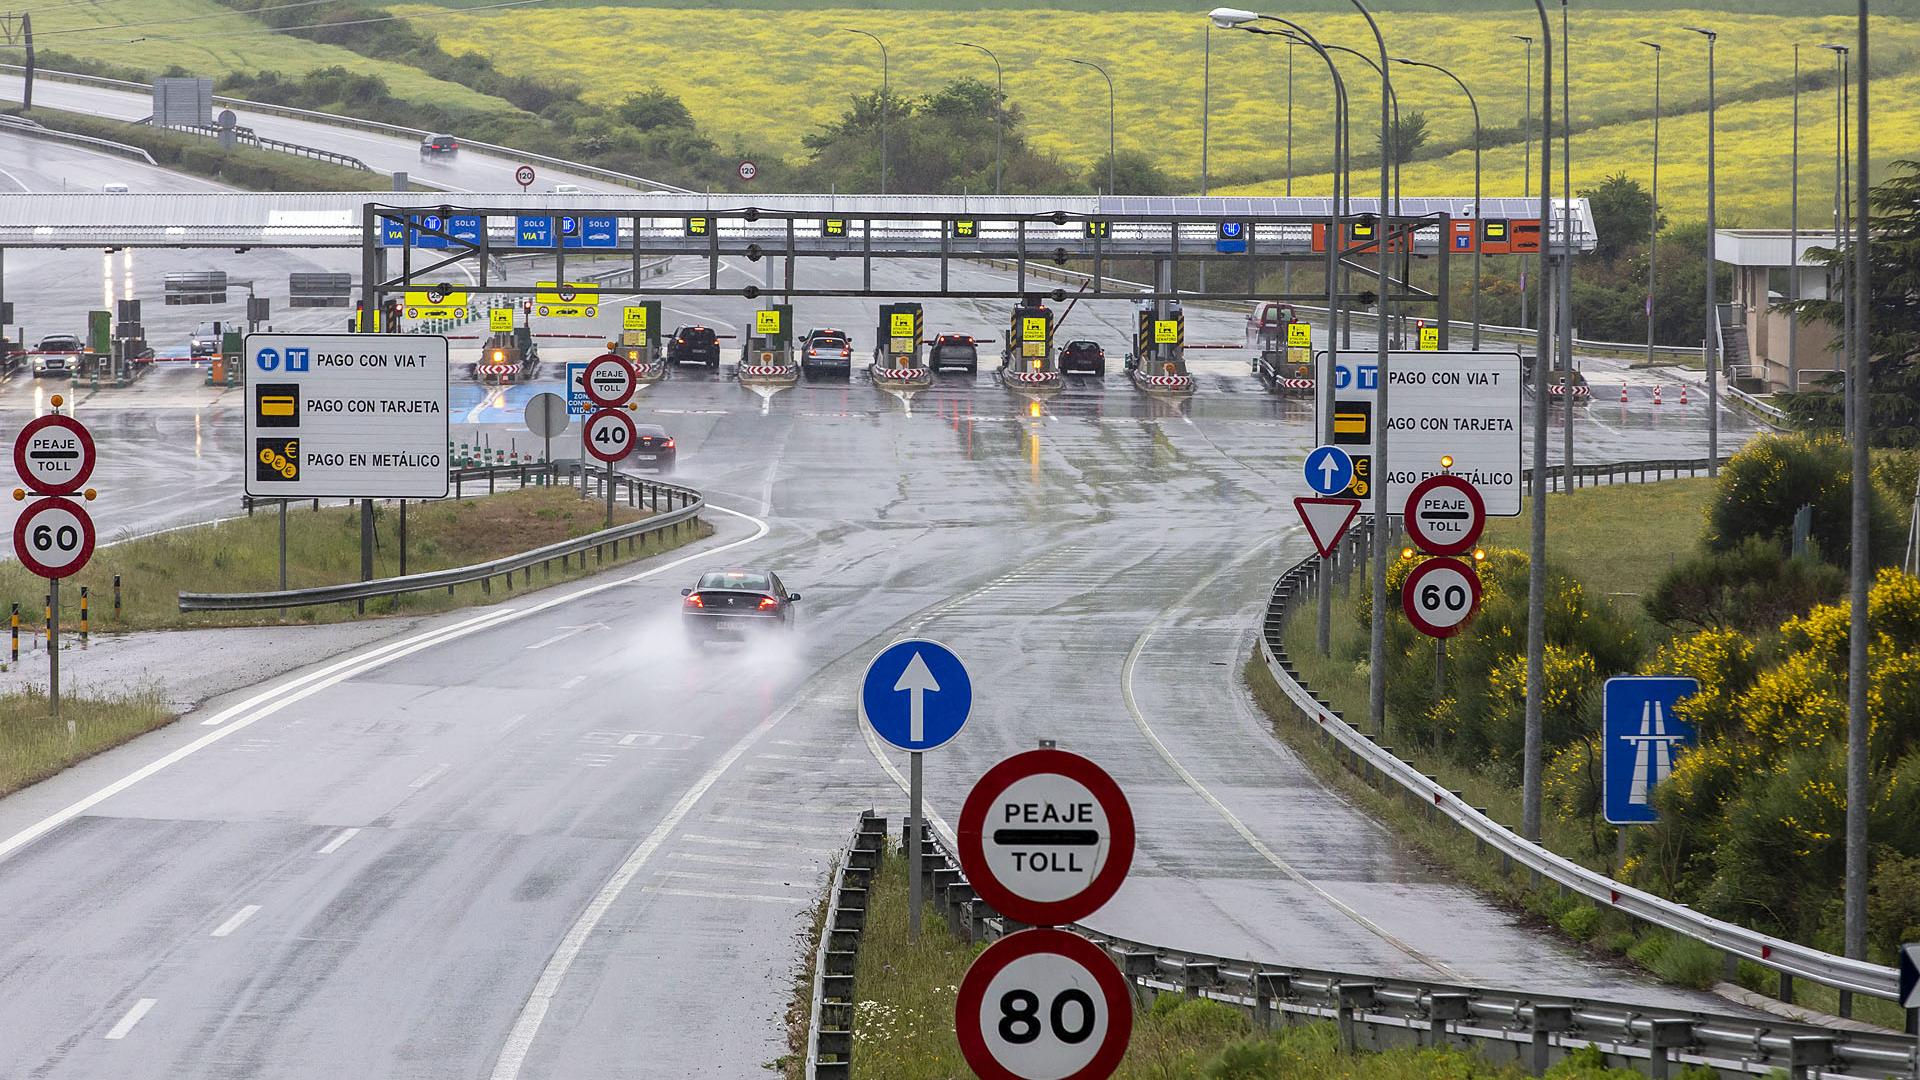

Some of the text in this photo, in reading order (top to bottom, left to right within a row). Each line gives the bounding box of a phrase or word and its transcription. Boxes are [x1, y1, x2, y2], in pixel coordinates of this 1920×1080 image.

[519, 172, 533, 180] 120
[741, 167, 755, 176] 120
[455, 219, 476, 227] SOLO
[389, 231, 403, 239] VIA
[523, 232, 537, 240] VIA
[317, 354, 427, 368] PAGO CON VIA T
[596, 370, 624, 378] PEAJE
[1389, 372, 1500, 385] PAGO CON VIA T
[598, 384, 621, 392] TOLL
[307, 399, 440, 413] PAGO CON TARJETA
[1386, 417, 1514, 431] AGO CON TARJETA
[595, 426, 626, 444] 40
[33, 439, 75, 449] PEAJE
[307, 450, 440, 467] PAGO EN METÁLICO
[37, 461, 72, 471] TOLL
[1386, 471, 1416, 485] AGO
[1424, 500, 1466, 510] PEAJE
[1428, 521, 1462, 532] TOLL
[33, 525, 78, 551] 60
[1421, 584, 1466, 611] 60
[1005, 803, 1094, 824] PEAJE
[1011, 852, 1083, 872] TOLL
[998, 988, 1096, 1044] 80
